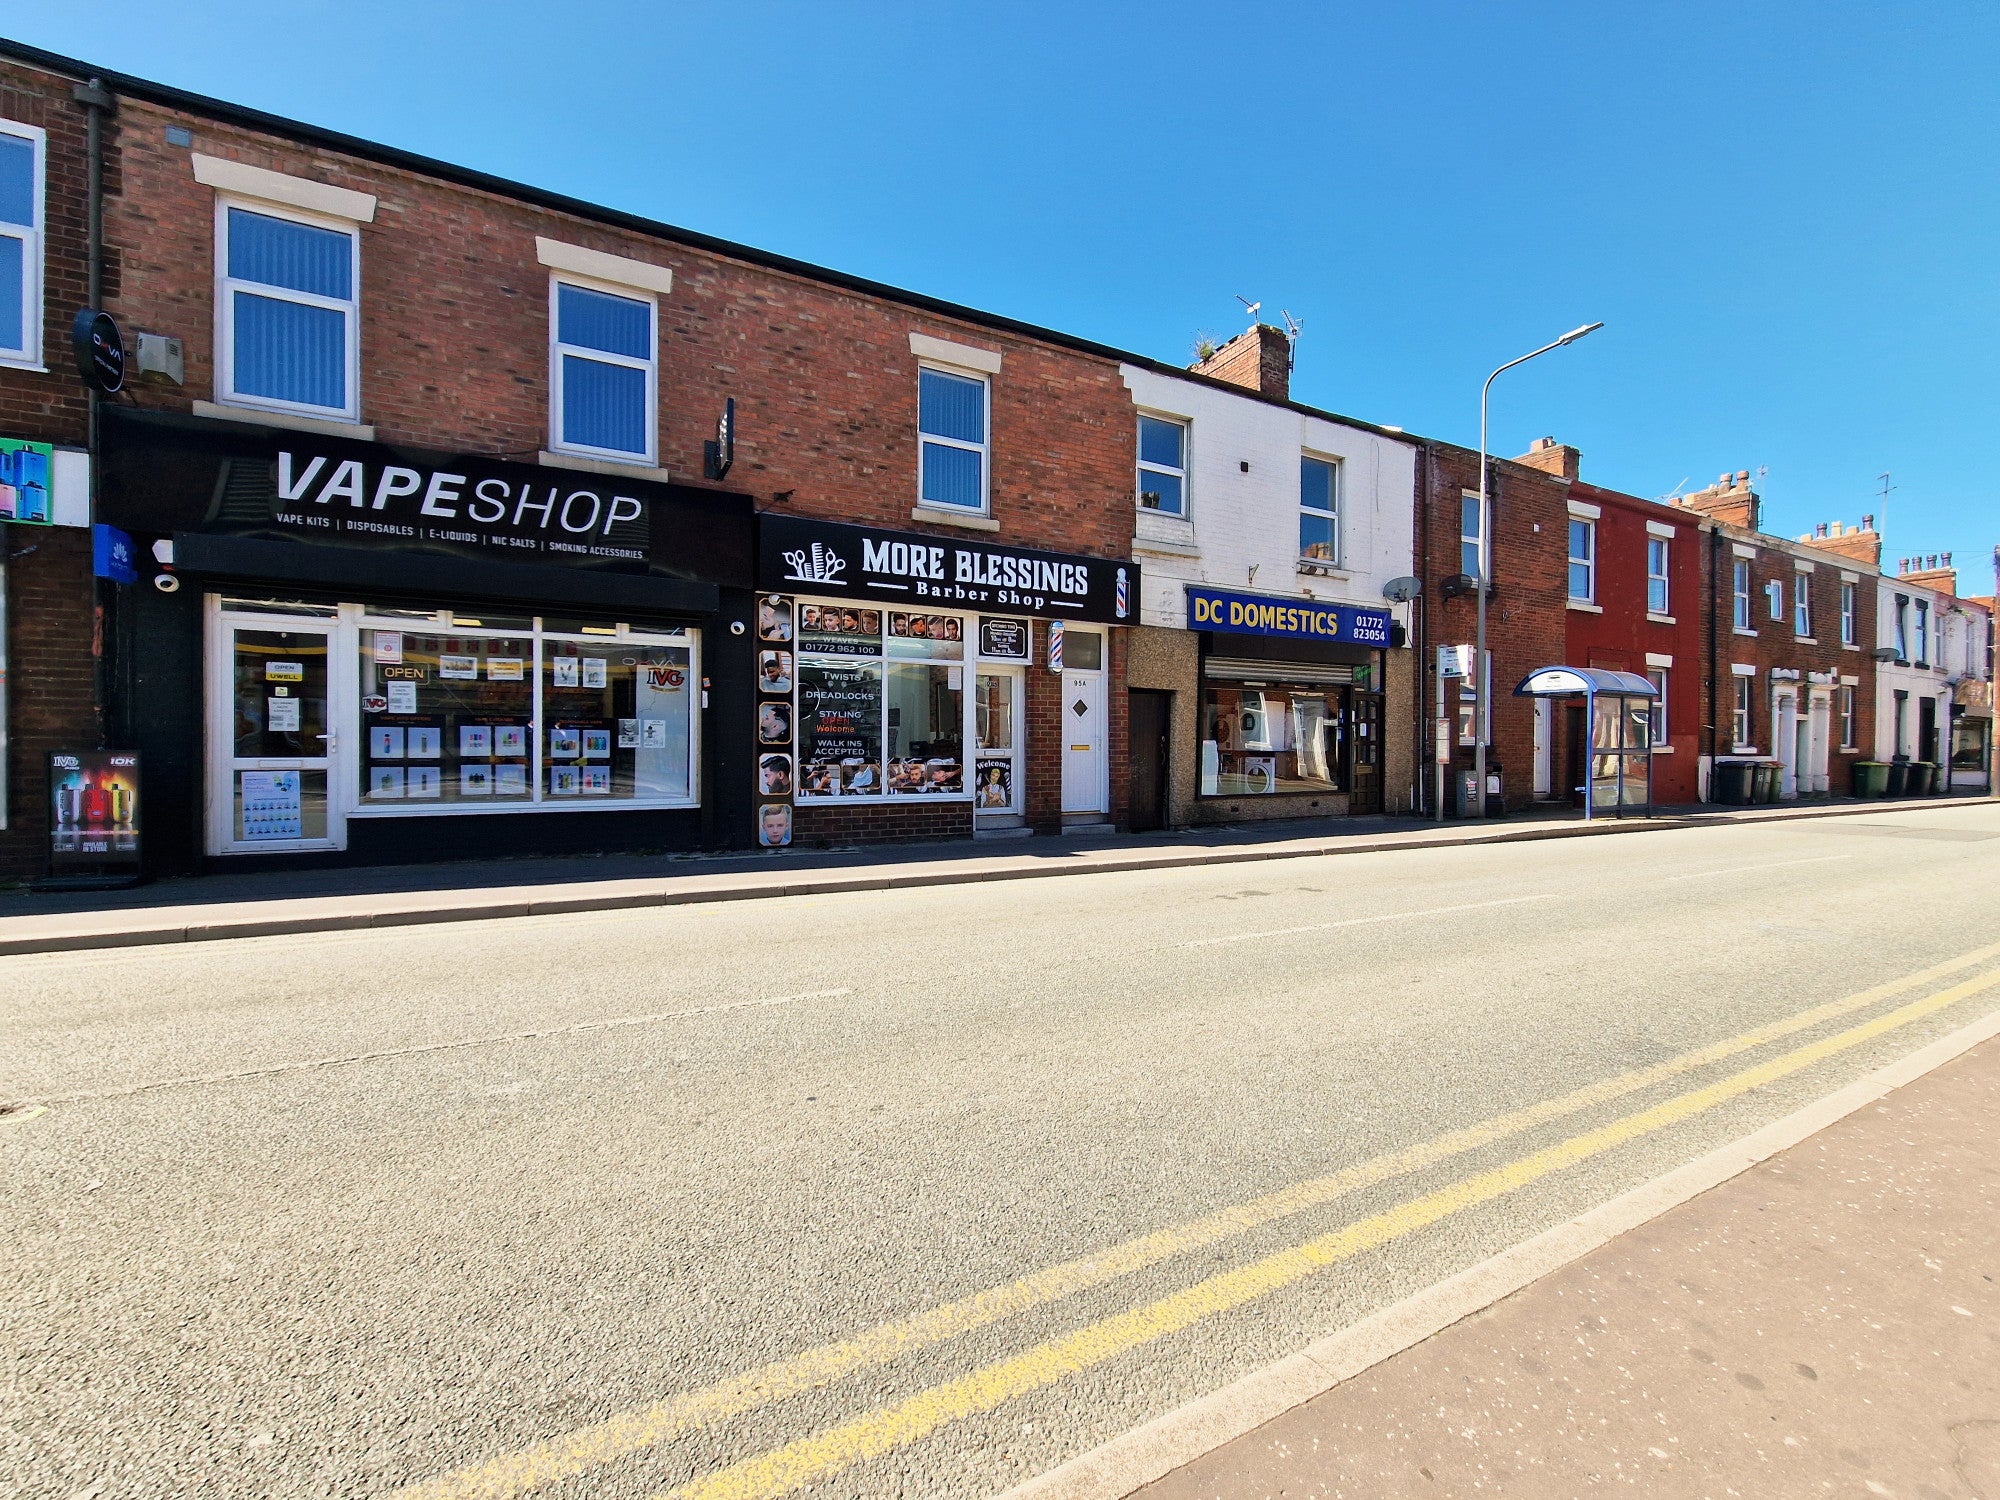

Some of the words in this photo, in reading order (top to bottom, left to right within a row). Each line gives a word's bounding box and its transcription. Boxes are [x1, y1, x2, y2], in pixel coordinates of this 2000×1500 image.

[276, 513, 303, 525] VAPE
[306, 516, 330, 527] KITS
[346, 520, 414, 536] DISPOSABLES
[429, 528, 478, 543] E-LIQUIDS
[491, 535, 508, 546] NIC
[509, 537, 537, 549] SALTS
[548, 541, 588, 554] SMOKING
[589, 546, 643, 560] ACCESSORIES
[861, 538, 945, 580] MORE
[954, 550, 1089, 596] BLESSINGS
[916, 581, 989, 602] Barber
[997, 587, 1045, 610] Shop
[1194, 597, 1224, 625] DC
[1229, 601, 1339, 636] DOMESTICS
[1356, 615, 1384, 629] 01772
[822, 636, 860, 645] WEAVES
[1353, 628, 1386, 642] 823054
[805, 643, 836, 653] 01772
[837, 645, 856, 654] 962
[859, 646, 875, 655] 100
[384, 666, 424, 679] OPEN
[645, 667, 685, 687] IVG
[822, 671, 862, 682] TWISTS
[805, 690, 875, 701] DREADLOCKS
[362, 698, 386, 709] IVG
[819, 709, 862, 719] STYLING
[815, 724, 855, 734] Welcome
[817, 739, 845, 748] WALK
[846, 740, 863, 748] INS
[814, 748, 865, 756] ACCEPTED
[53, 755, 79, 767] IVG
[976, 759, 1011, 771] Welcome
